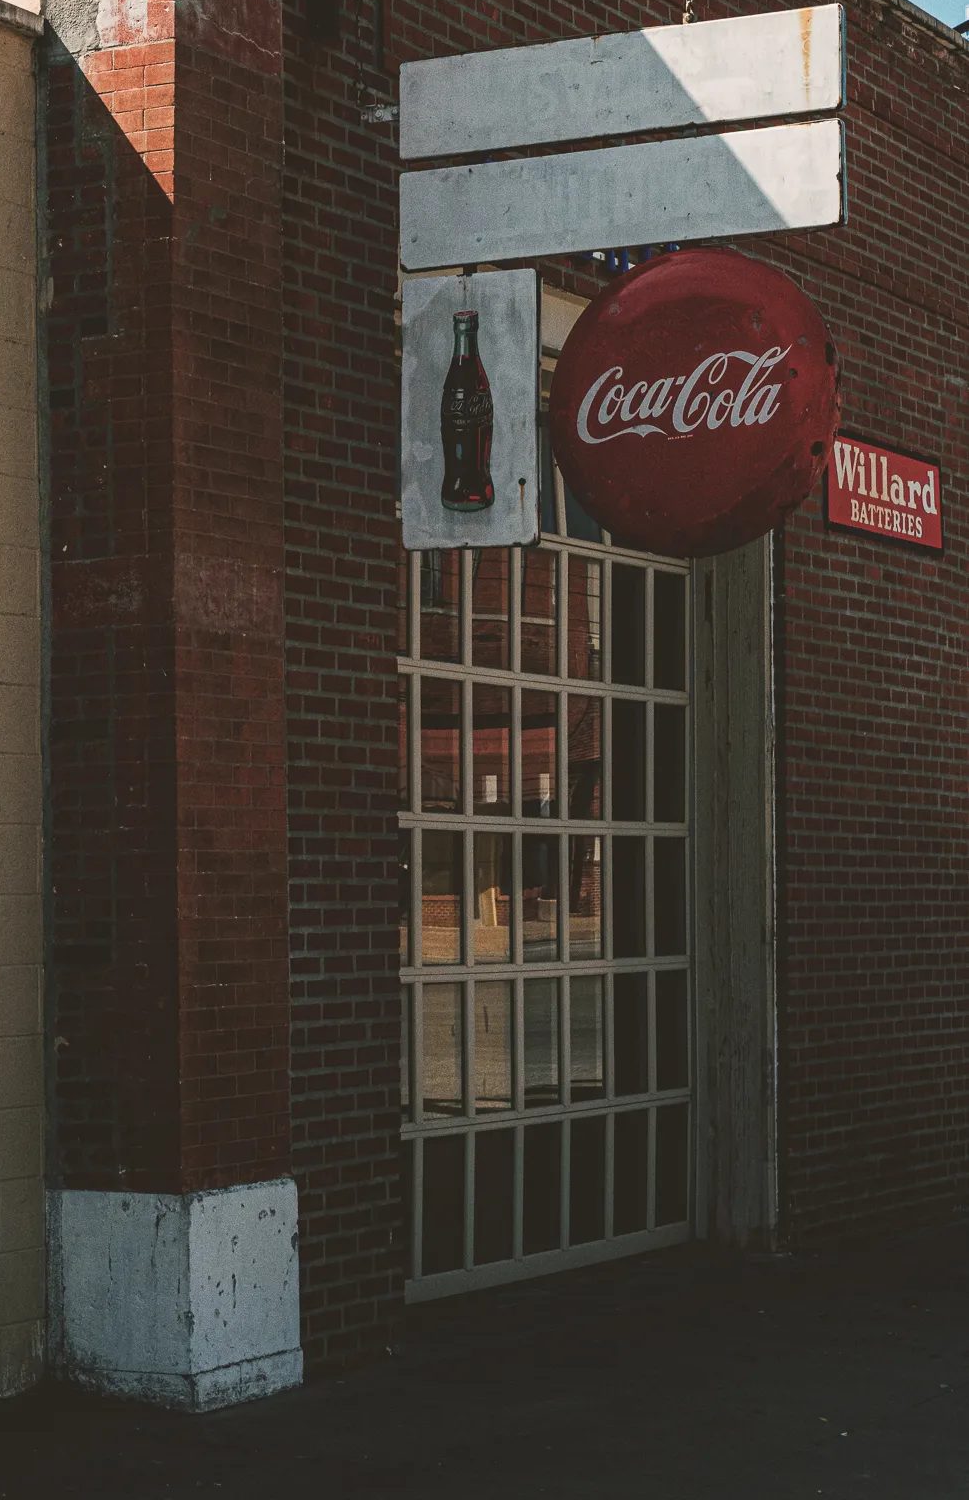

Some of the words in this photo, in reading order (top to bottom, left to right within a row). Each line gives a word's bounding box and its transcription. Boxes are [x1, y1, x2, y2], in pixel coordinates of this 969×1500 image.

[577, 344, 793, 444] Coca-Cola
[833, 440, 938, 515] Willard
[850, 499, 923, 538] BATTERIES
